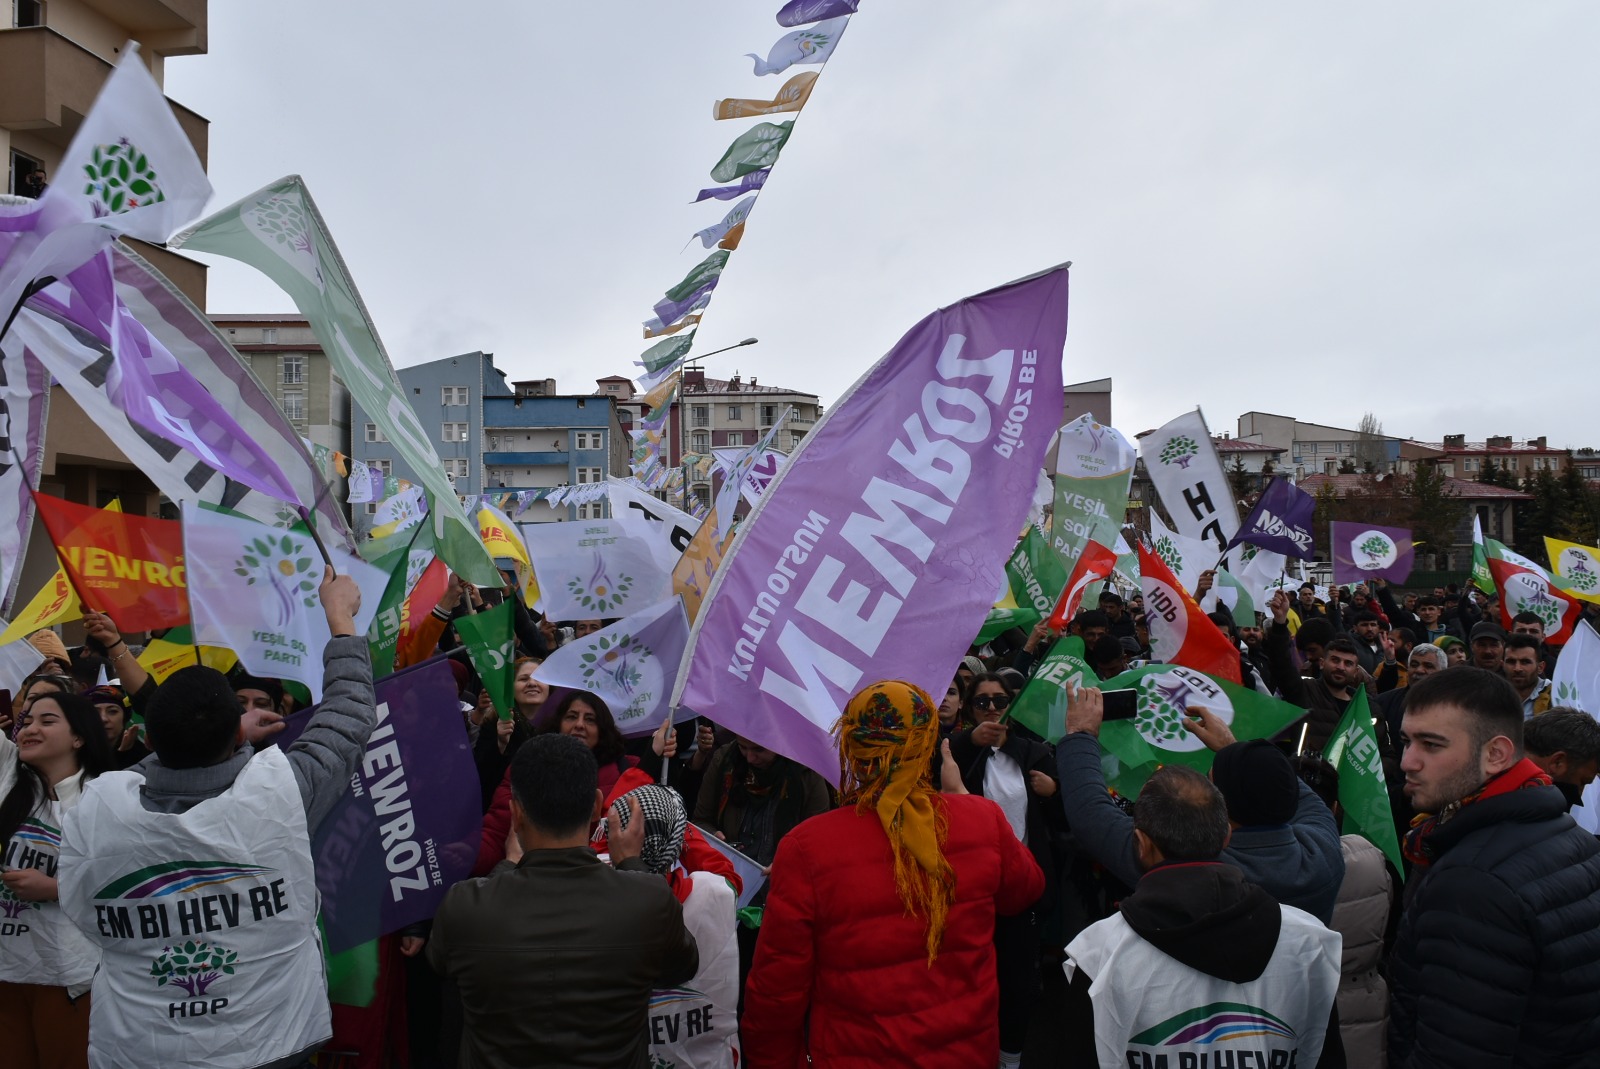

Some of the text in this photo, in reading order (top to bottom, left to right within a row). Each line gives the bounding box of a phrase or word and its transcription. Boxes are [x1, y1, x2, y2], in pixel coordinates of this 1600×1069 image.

[1063, 491, 1110, 519] YEŞİL
[1054, 535, 1082, 560] PAR
[94, 877, 289, 940] EM BI HEV RE
[0, 922, 30, 937] DP
[169, 997, 229, 1019] HDP
[687, 1003, 714, 1038] RE
